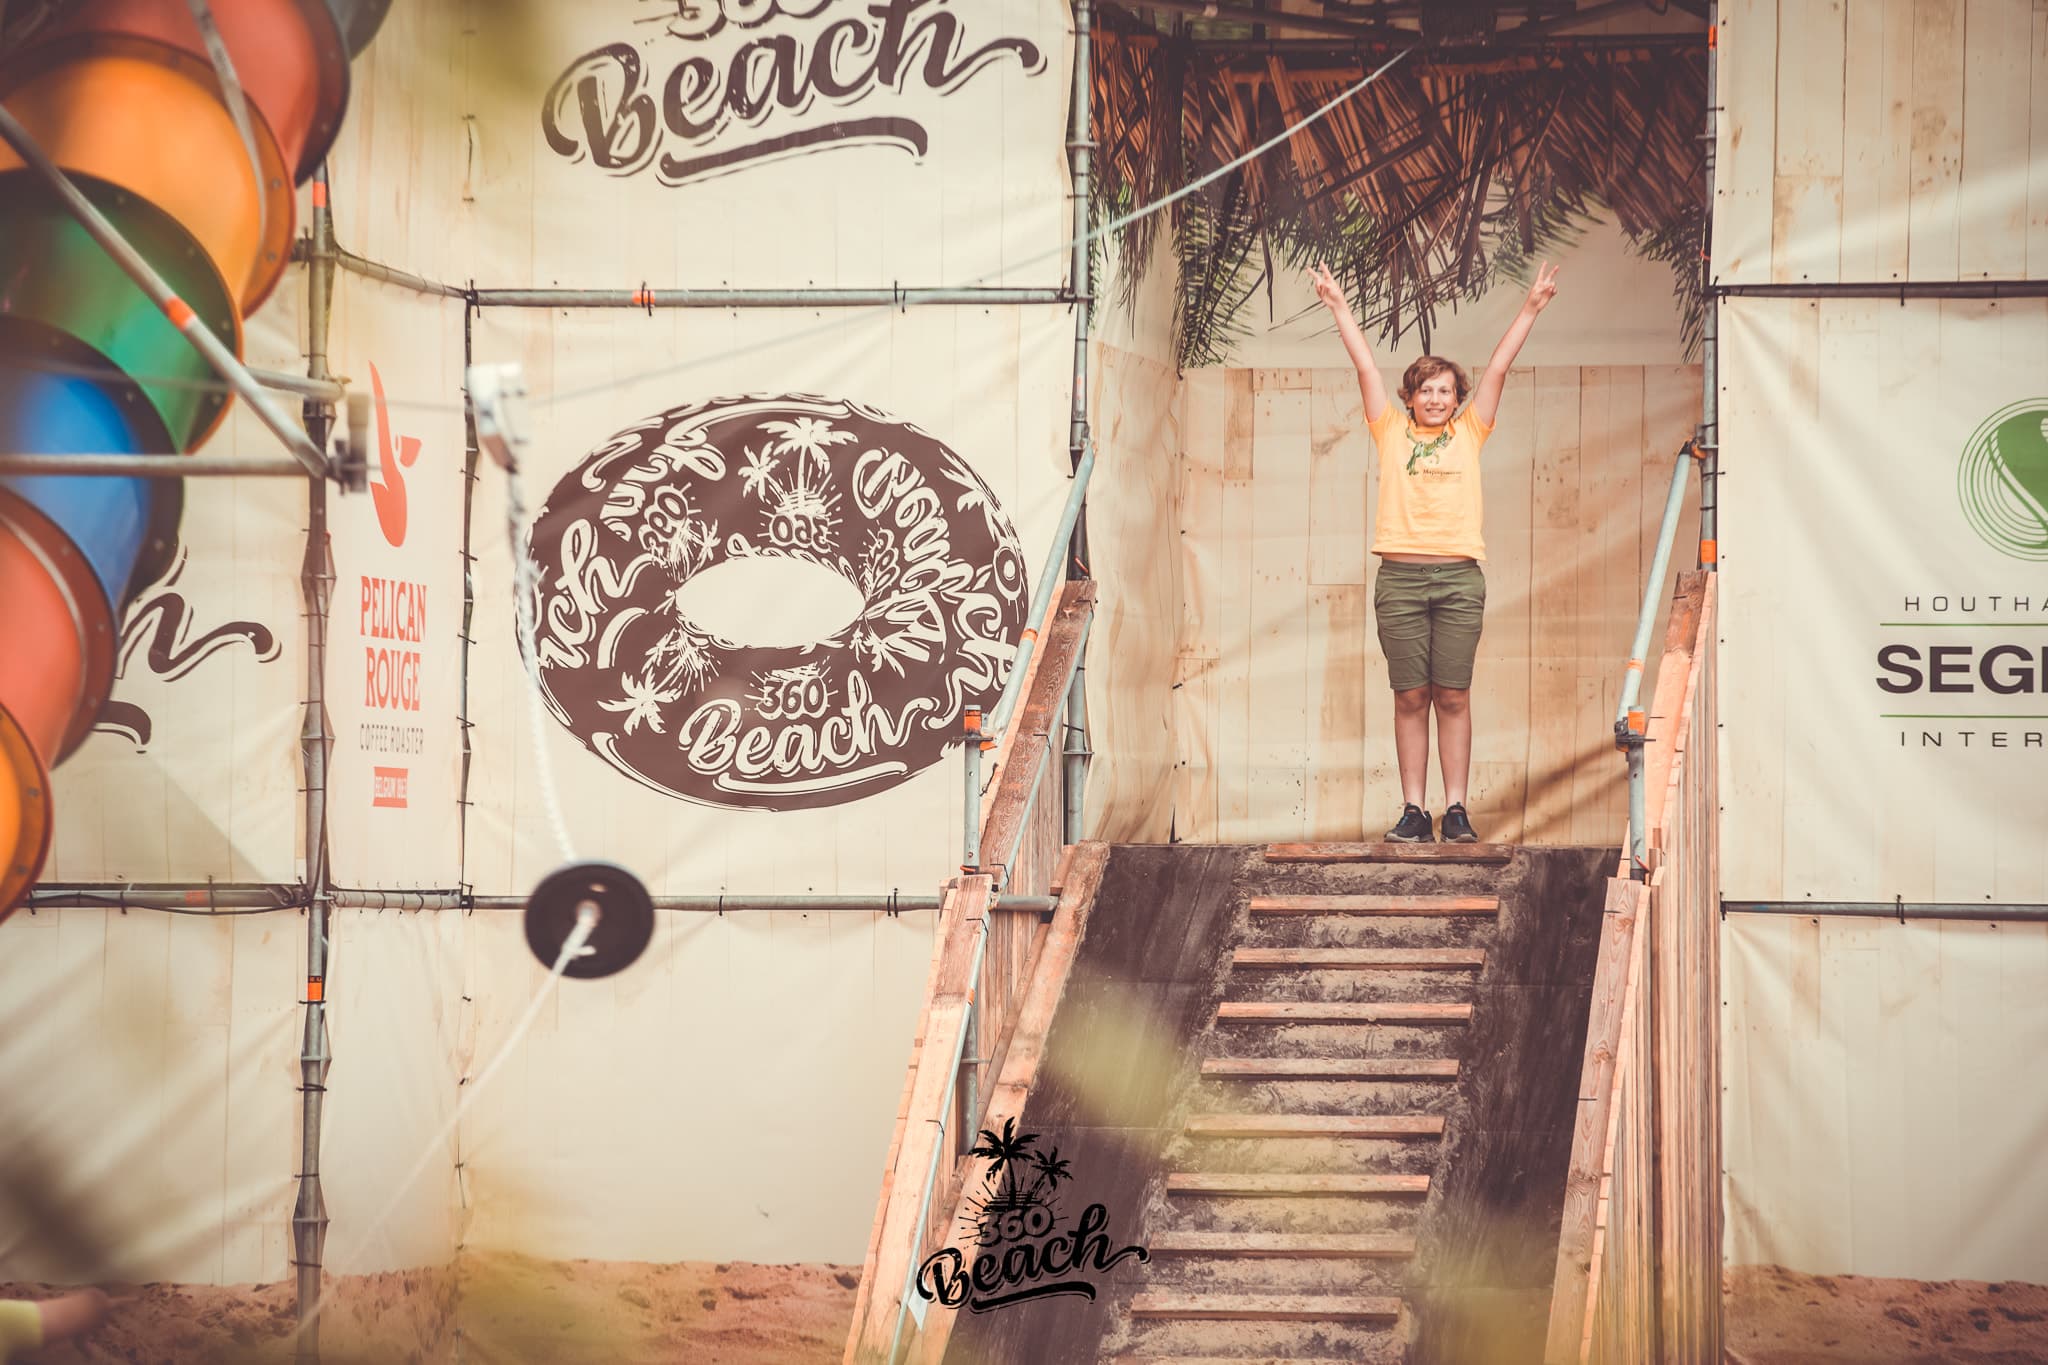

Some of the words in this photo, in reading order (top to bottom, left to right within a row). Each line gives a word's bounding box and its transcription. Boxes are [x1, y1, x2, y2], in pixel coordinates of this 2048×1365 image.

[541, 0, 1047, 177] Beach
[360, 575, 427, 643] PELICAN
[365, 646, 421, 711] ROUGE
[757, 675, 828, 720] 360
[1876, 644, 2048, 694] SEG
[360, 723, 388, 753] COFFEE
[679, 670, 938, 779] Beach
[1901, 732, 2043, 748] INTER
